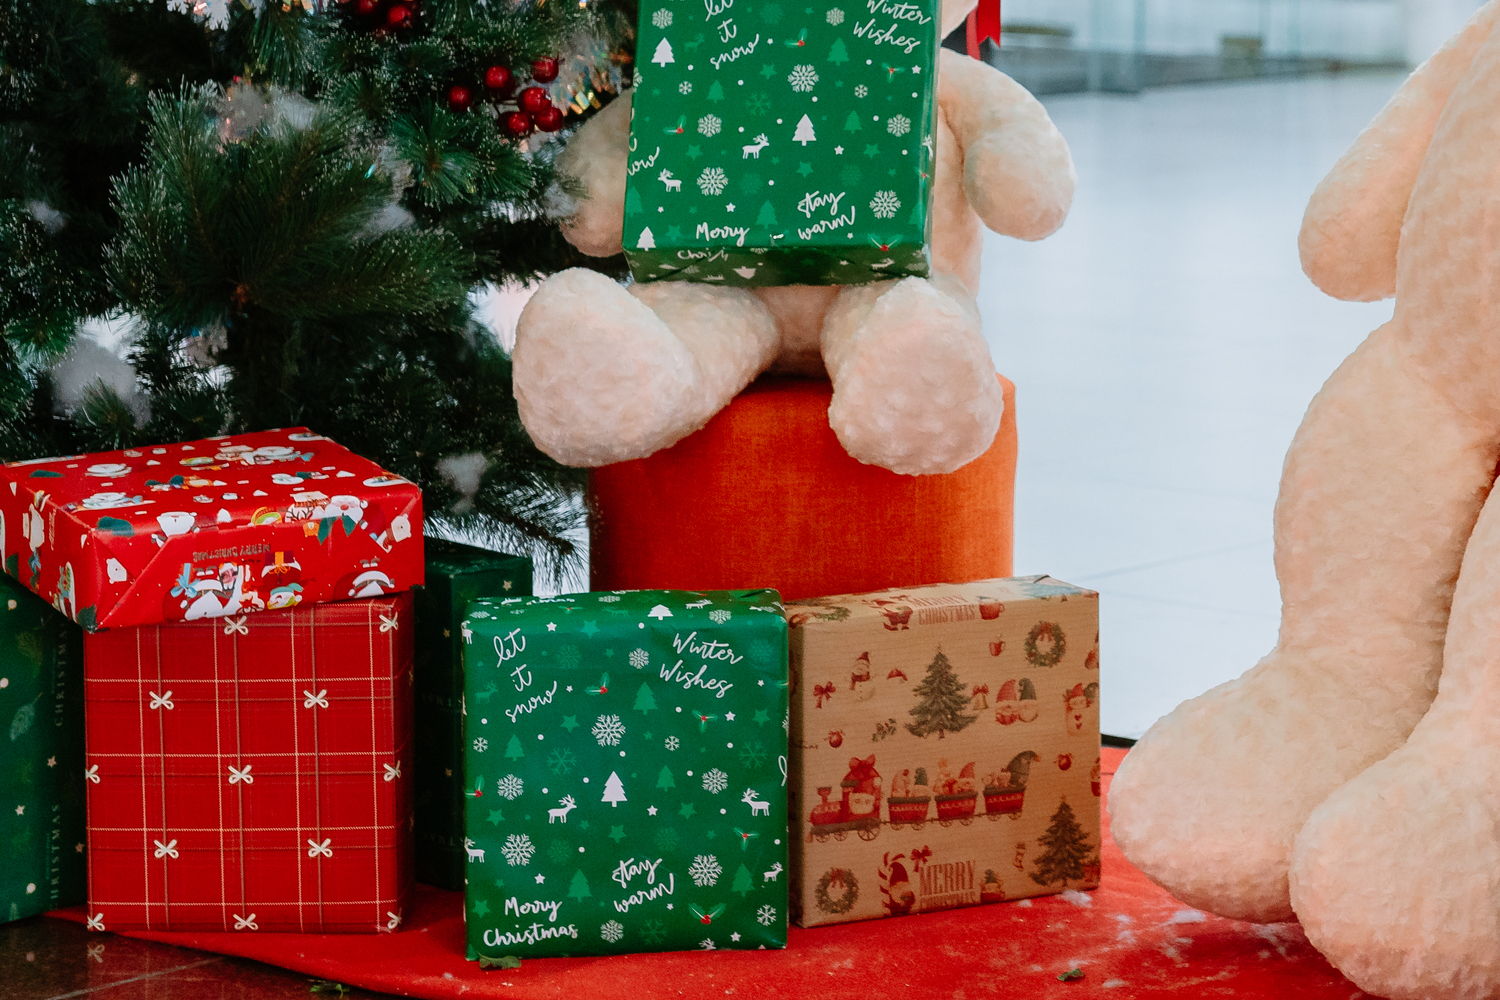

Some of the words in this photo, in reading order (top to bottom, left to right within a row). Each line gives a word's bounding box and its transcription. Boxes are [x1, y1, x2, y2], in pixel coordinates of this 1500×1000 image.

[717, 18, 737, 44] it
[853, 18, 921, 54] Wishes
[709, 33, 760, 70] snow
[797, 191, 846, 218] stay
[695, 222, 750, 247] Merry
[797, 205, 856, 241] warm
[192, 546, 239, 563] CHRISTMAS
[240, 543, 271, 556] MERRY
[494, 628, 527, 668] let
[672, 631, 744, 666] Winter
[53, 622, 68, 727] CHRISTMA
[510, 663, 533, 692] it
[659, 659, 735, 699] Wishes
[505, 680, 558, 724] snow
[611, 858, 664, 889] stay
[919, 859, 976, 897] MERRY
[504, 896, 563, 922] Merry
[613, 873, 675, 913] warm
[483, 923, 579, 947] Christmas
